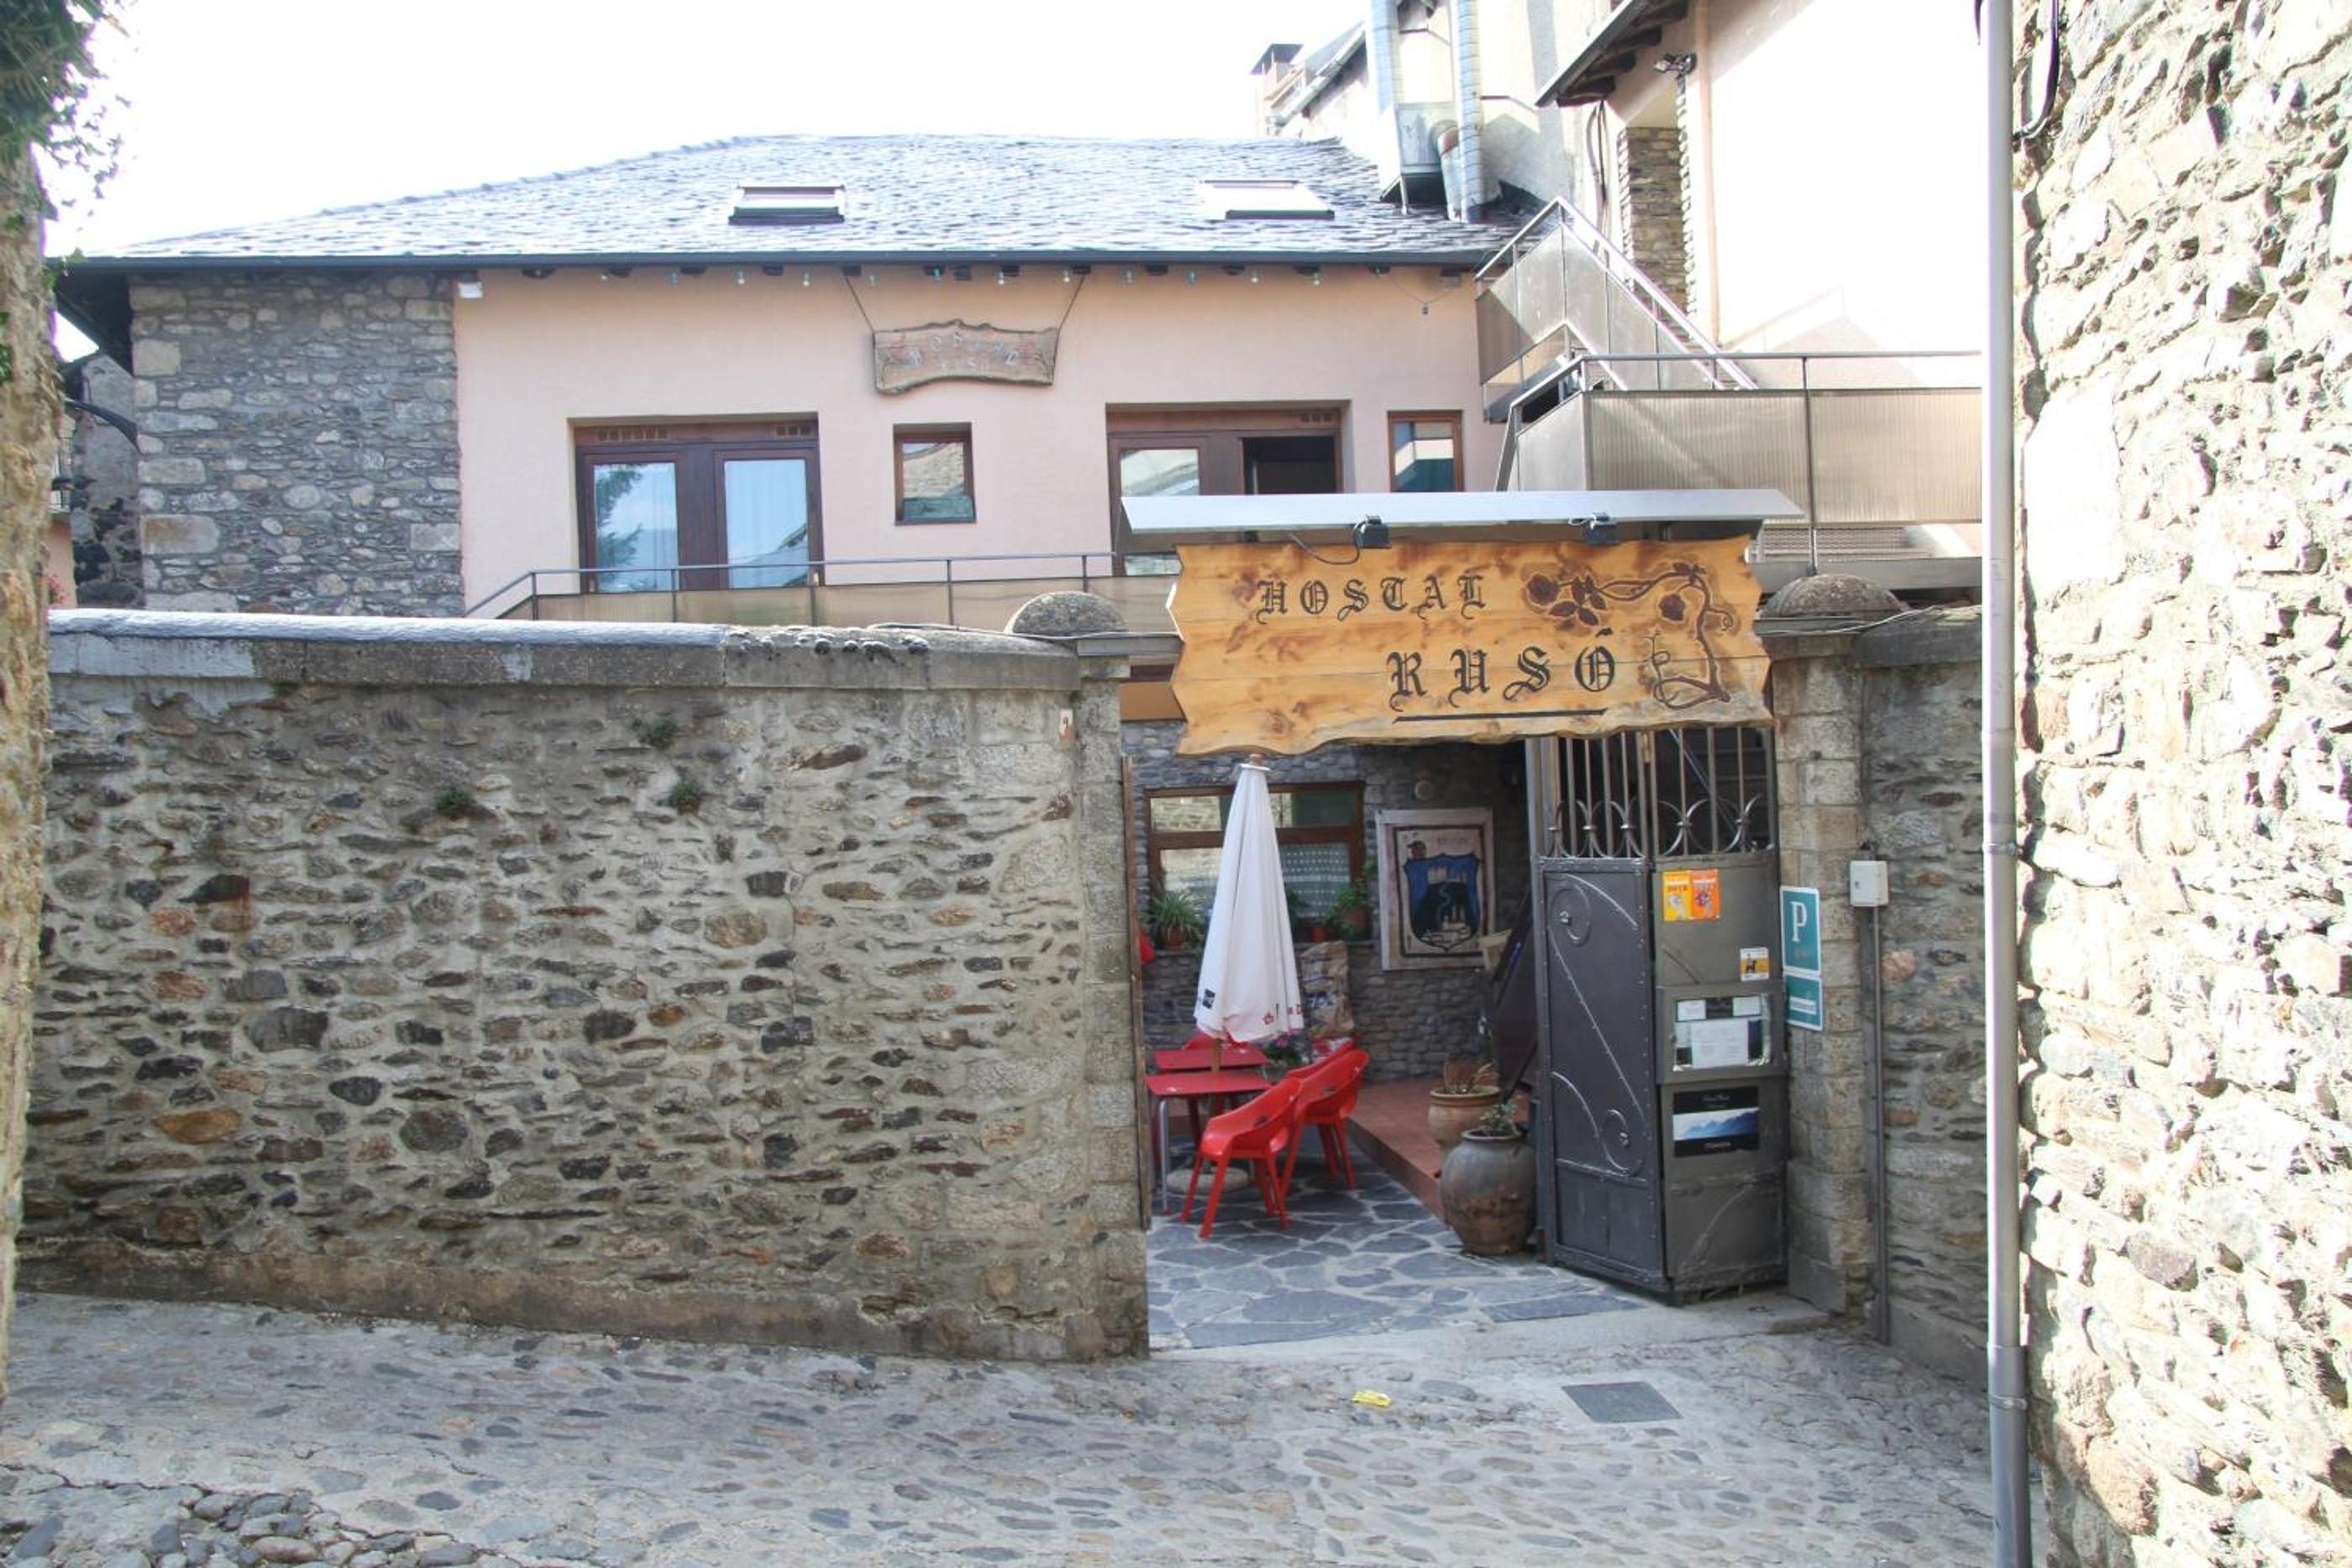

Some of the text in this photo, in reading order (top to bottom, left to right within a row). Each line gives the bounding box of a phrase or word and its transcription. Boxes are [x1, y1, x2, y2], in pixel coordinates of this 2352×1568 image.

[1256, 574, 1487, 625] HOSTAL
[1386, 627, 1615, 712] RUSÓ
[1789, 900, 1808, 943] P
